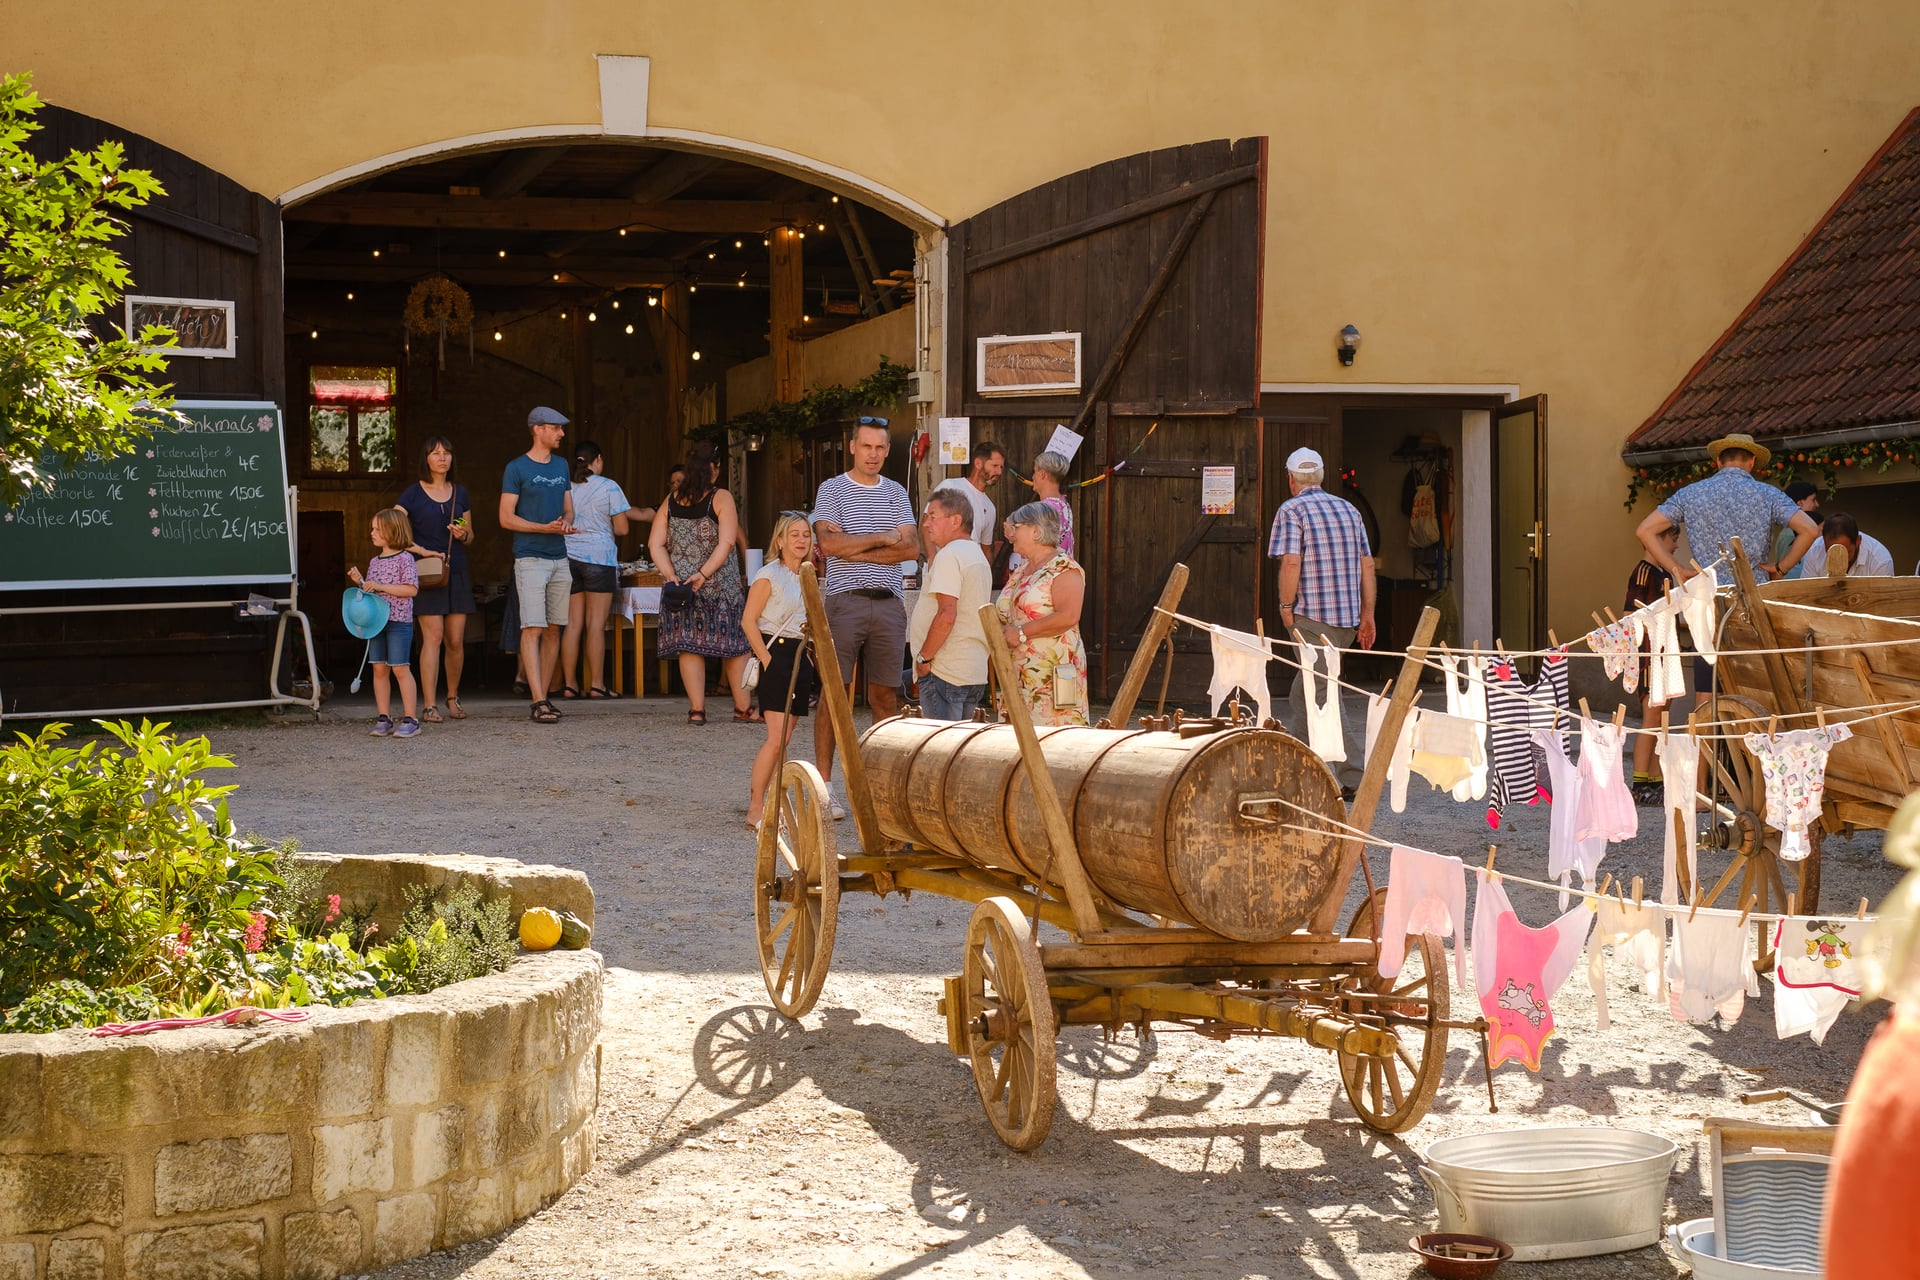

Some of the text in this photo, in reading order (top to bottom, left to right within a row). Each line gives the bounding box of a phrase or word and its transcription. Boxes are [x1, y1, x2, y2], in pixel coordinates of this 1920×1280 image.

[225, 446, 233, 456] &
[239, 455, 260, 471] 4€
[53, 465, 140, 481] nlimonade 1€
[156, 465, 226, 478] Zwiebelkuchen
[106, 484, 124, 500] 1€
[153, 481, 264, 501] Fettbemme 1,50€
[15, 507, 113, 528] Kaffee 1,50€
[161, 502, 222, 517] Kuchen 2€
[161, 520, 218, 544] Waffeln
